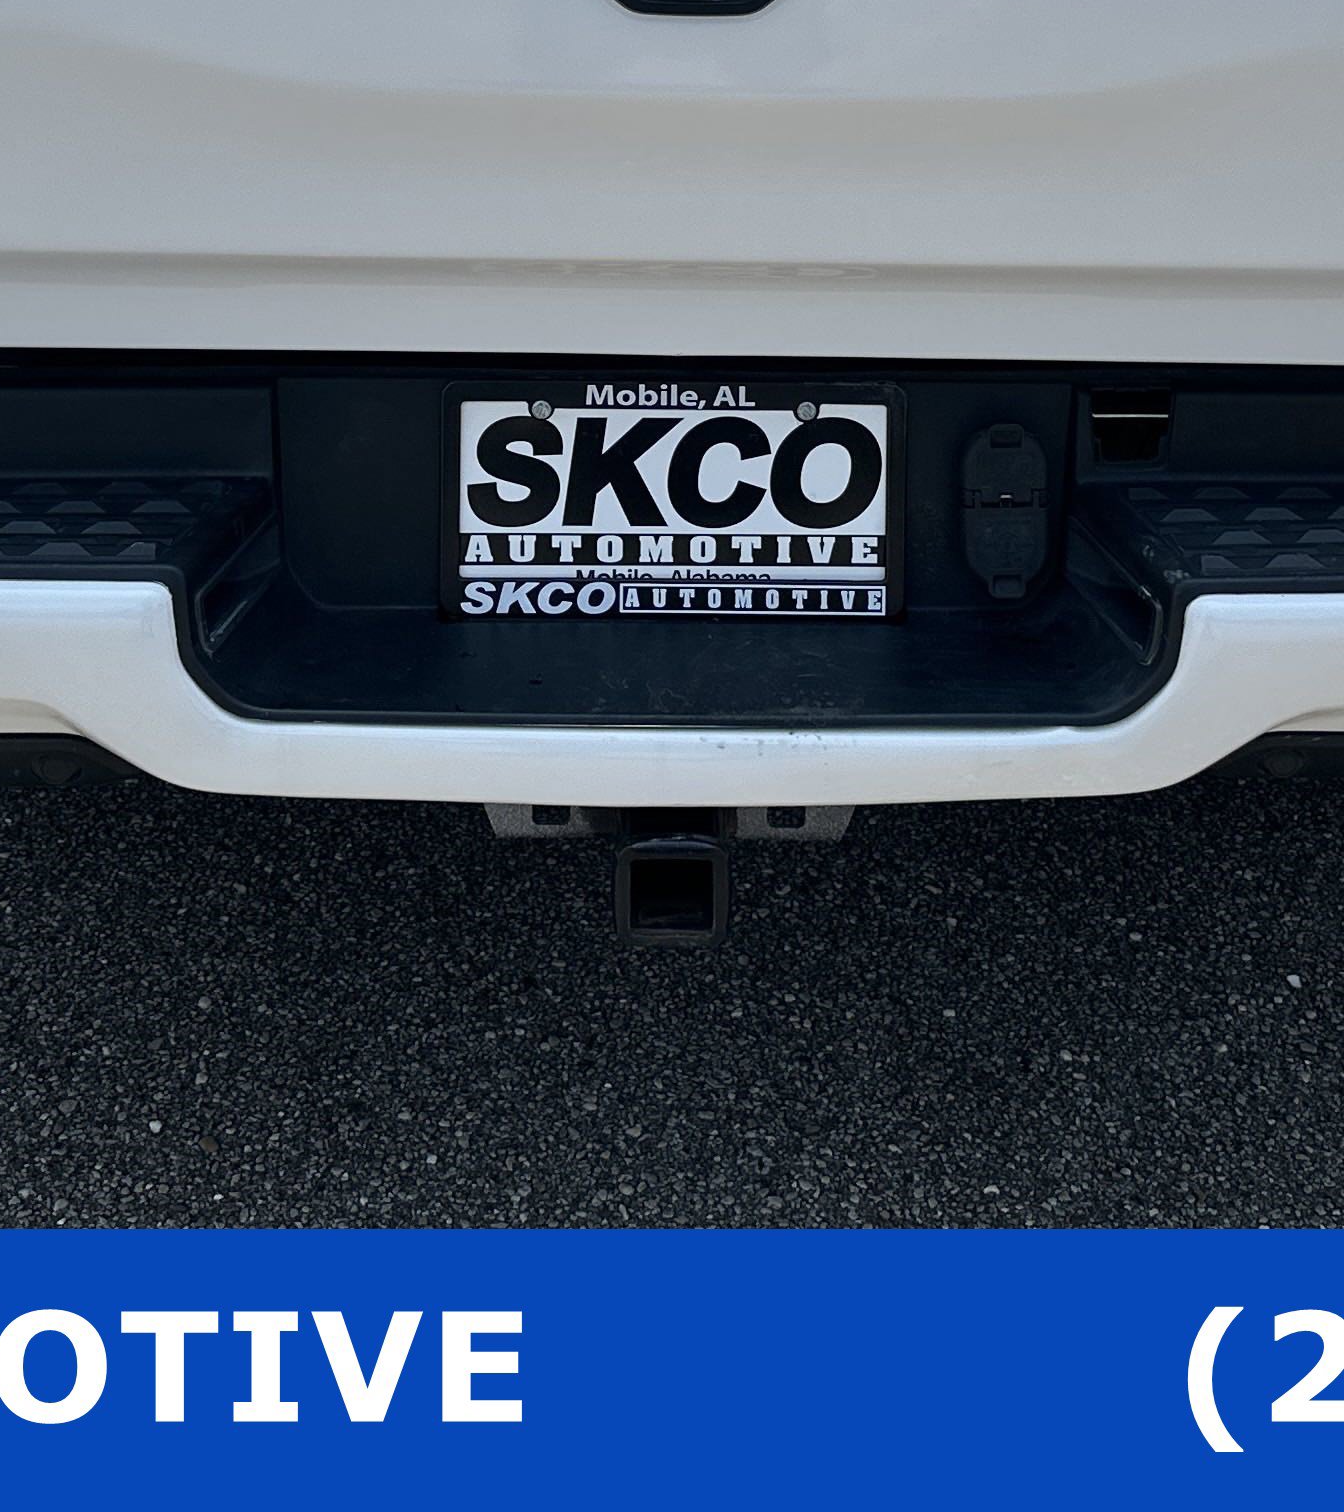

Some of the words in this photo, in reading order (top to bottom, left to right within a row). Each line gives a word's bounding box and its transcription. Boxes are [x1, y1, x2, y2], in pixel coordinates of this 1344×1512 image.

[585, 384, 707, 410] Mobile,
[713, 385, 756, 408] AL
[466, 415, 883, 530] SKCO
[464, 534, 881, 565] AUTOMOTIVE
[460, 581, 616, 615] SKCO
[624, 588, 883, 610] AUTOMOTIVE
